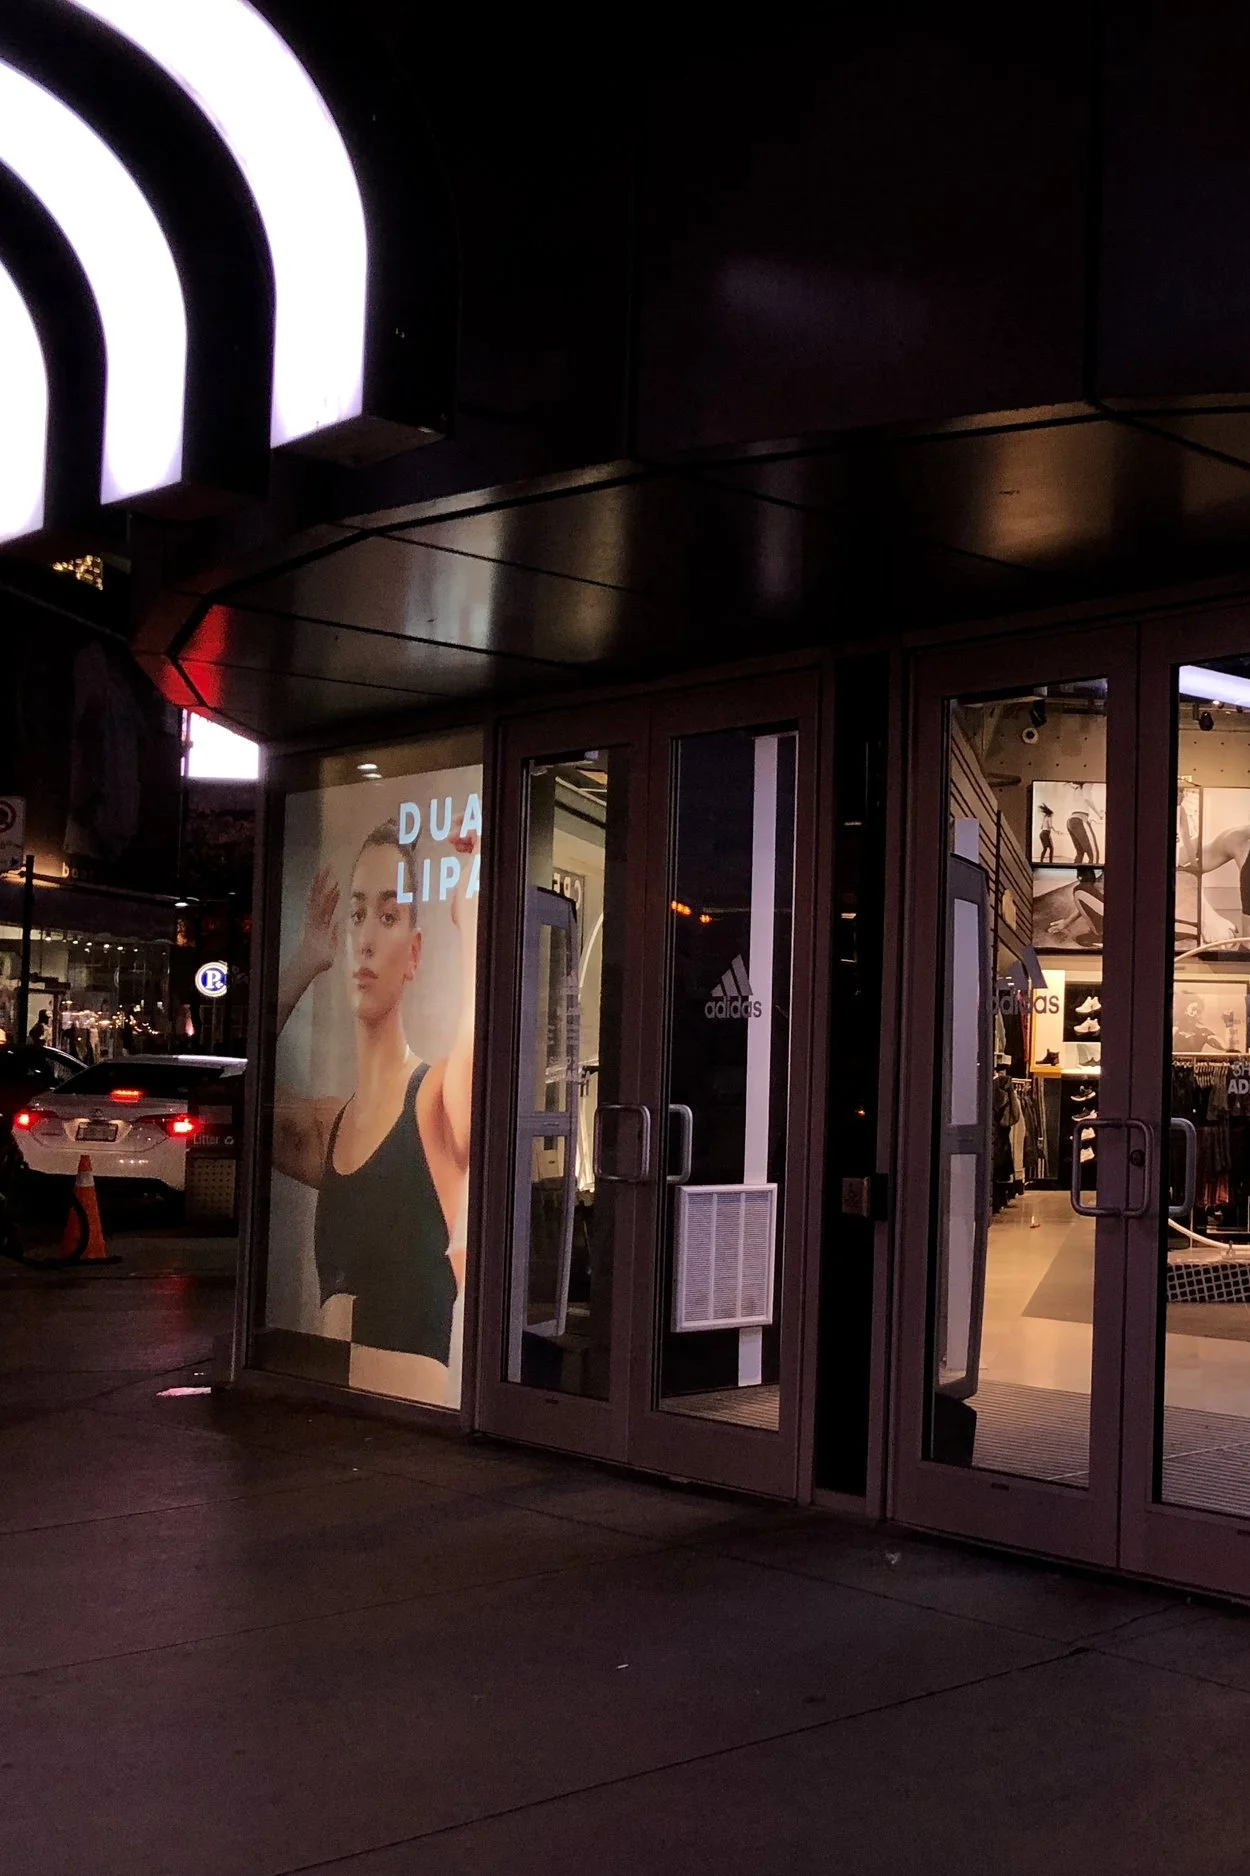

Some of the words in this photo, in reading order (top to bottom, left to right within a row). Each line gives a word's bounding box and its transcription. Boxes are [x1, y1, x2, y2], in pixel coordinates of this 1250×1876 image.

[399, 793, 482, 845] DUA
[704, 996, 762, 1019] adidas
[985, 983, 1059, 1016] adidas
[193, 1134, 221, 1146] Litter
